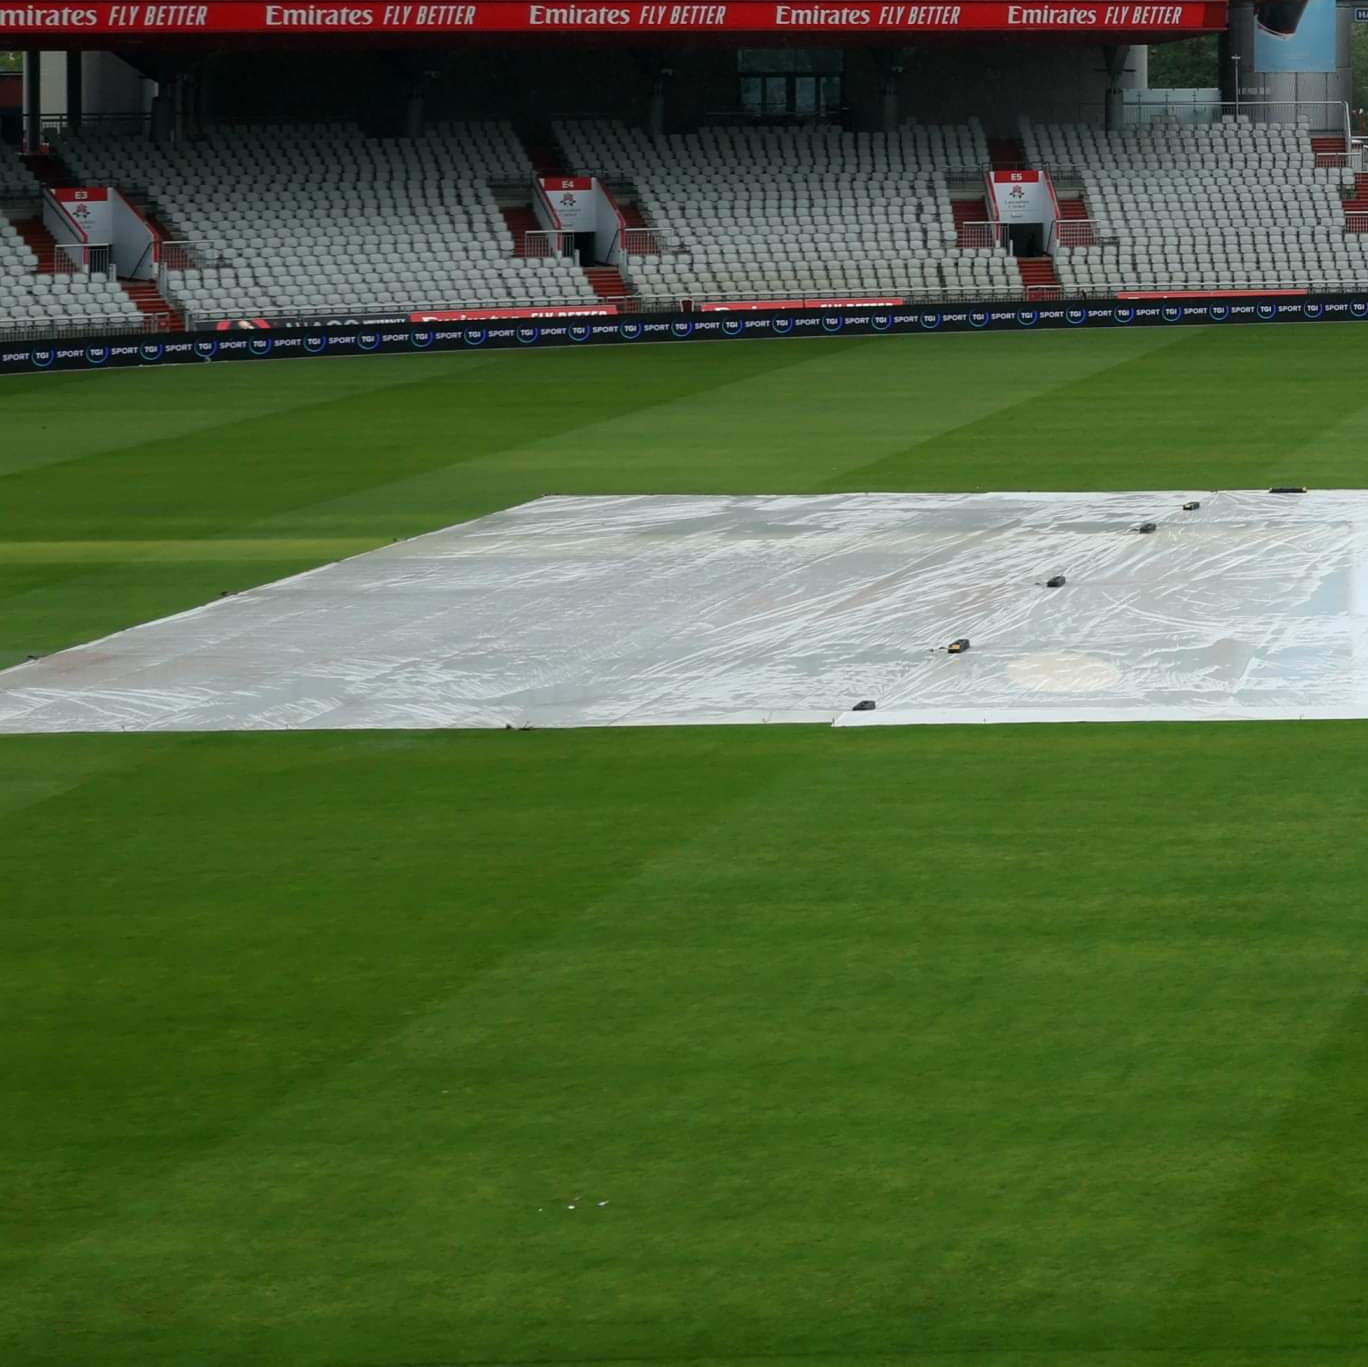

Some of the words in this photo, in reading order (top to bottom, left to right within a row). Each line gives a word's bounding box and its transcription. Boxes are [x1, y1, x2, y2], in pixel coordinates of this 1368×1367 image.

[0, 5, 97, 26] mirates
[108, 5, 140, 26] FLY
[143, 5, 208, 26] BETTER
[265, 5, 373, 26] Emirates
[383, 5, 413, 26] FLY
[416, 5, 476, 26] BETTER
[529, 5, 630, 25] Emirates
[639, 5, 667, 25] FLY
[670, 5, 727, 25] BETTER
[775, 5, 871, 25] Emirates
[878, 5, 905, 25] FLY
[907, 5, 961, 25] BETTER
[1007, 5, 1097, 25] Emirates
[1104, 5, 1130, 25] FLY
[1132, 5, 1183, 25] BETTER
[1010, 173, 1023, 181] E5
[561, 180, 575, 189] E4
[74, 191, 88, 200] E3
[991, 312, 1015, 320] SPORT
[1136, 308, 1160, 316] SPORT
[795, 318, 820, 326] SPORT
[844, 317, 870, 325] SPORT
[893, 315, 918, 323] SPORT
[643, 323, 670, 331] SPORT
[694, 322, 720, 330] SPORT
[745, 320, 770, 328] SPORT
[488, 329, 515, 337] SPORT
[540, 327, 567, 335] SPORT
[592, 325, 618, 333] SPORT
[382, 334, 409, 342] SPORT
[435, 331, 462, 339] SPORT
[274, 338, 301, 347] SPORT
[328, 336, 356, 344] SPORT
[165, 343, 192, 352] SPORT
[219, 341, 247, 349] SPORT
[57, 349, 84, 358] SPORT
[111, 346, 138, 355] SPORT
[2, 352, 29, 361] SPORT
